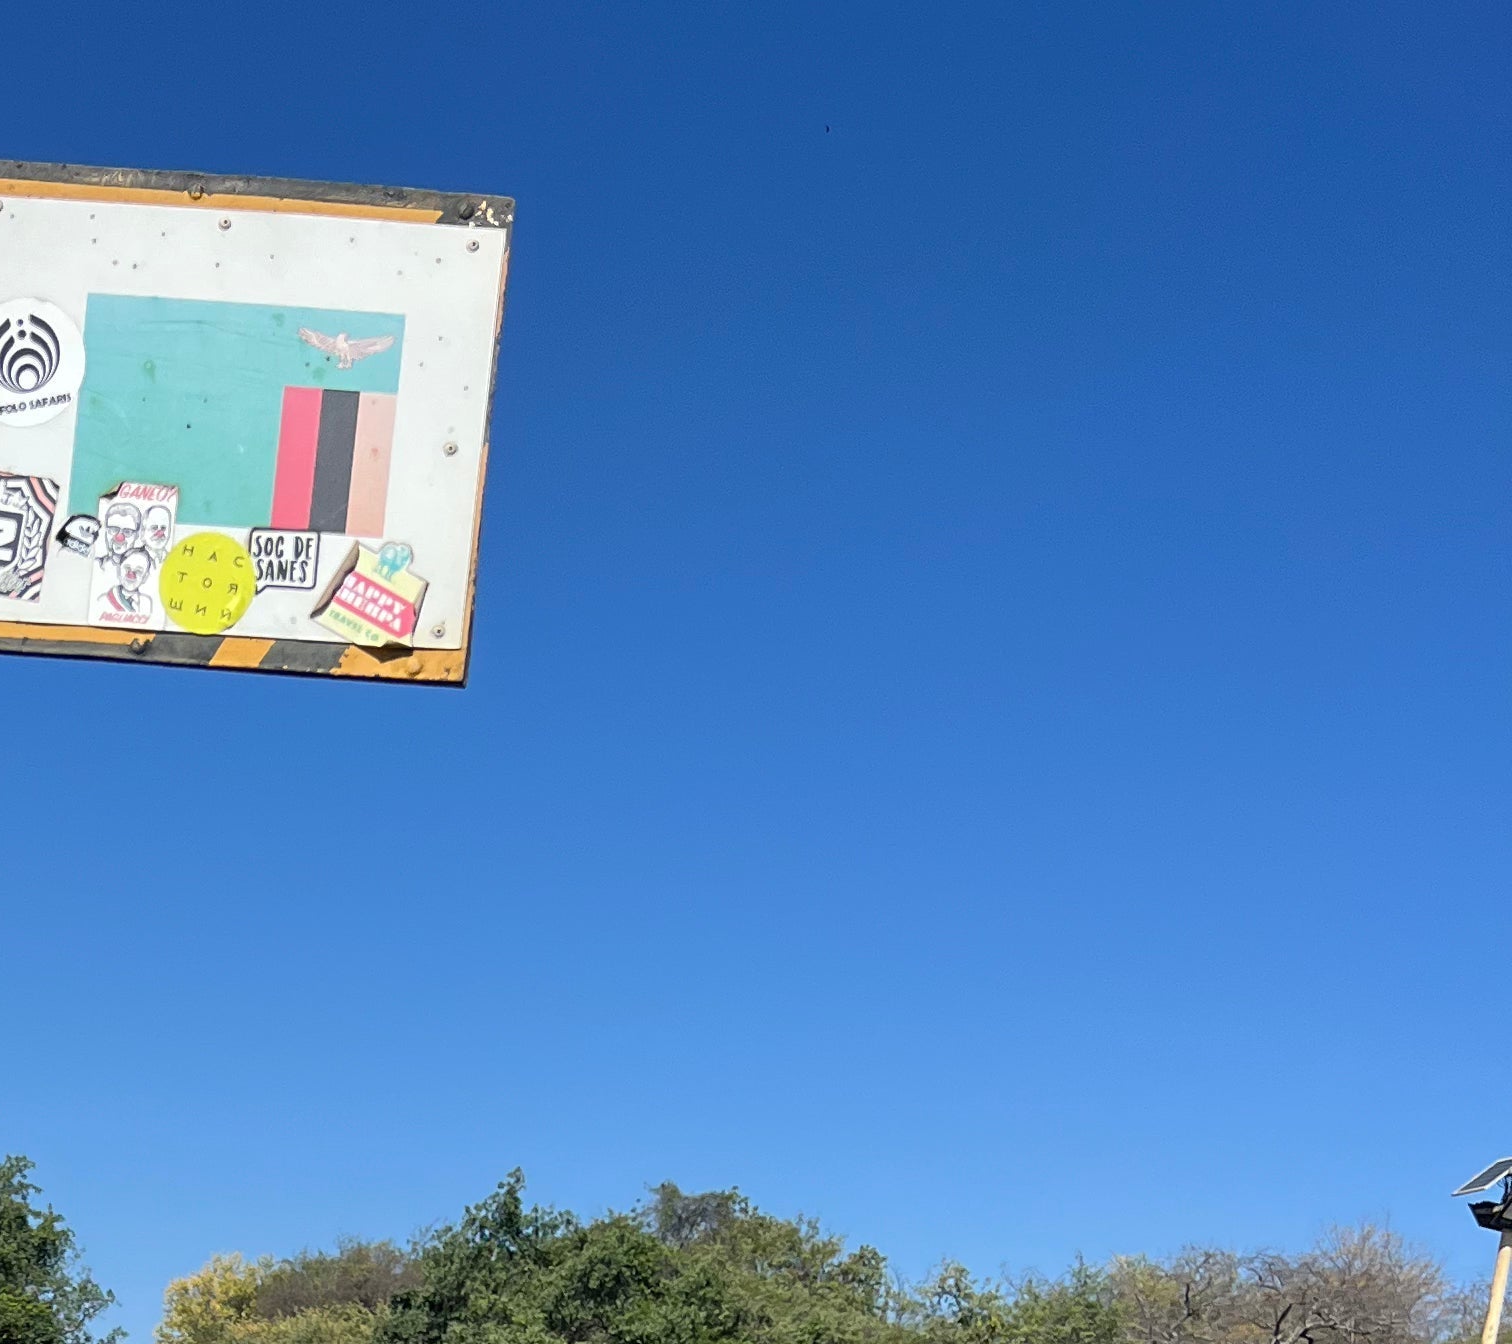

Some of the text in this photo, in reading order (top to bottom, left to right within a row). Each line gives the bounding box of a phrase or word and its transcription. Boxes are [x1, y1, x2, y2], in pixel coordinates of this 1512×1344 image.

[28, 392, 72, 410] SAFARIS
[252, 535, 314, 560] SOC DE
[256, 558, 309, 584] SANES
[328, 609, 363, 634] TRAVEL
[338, 588, 402, 632] HERPA
